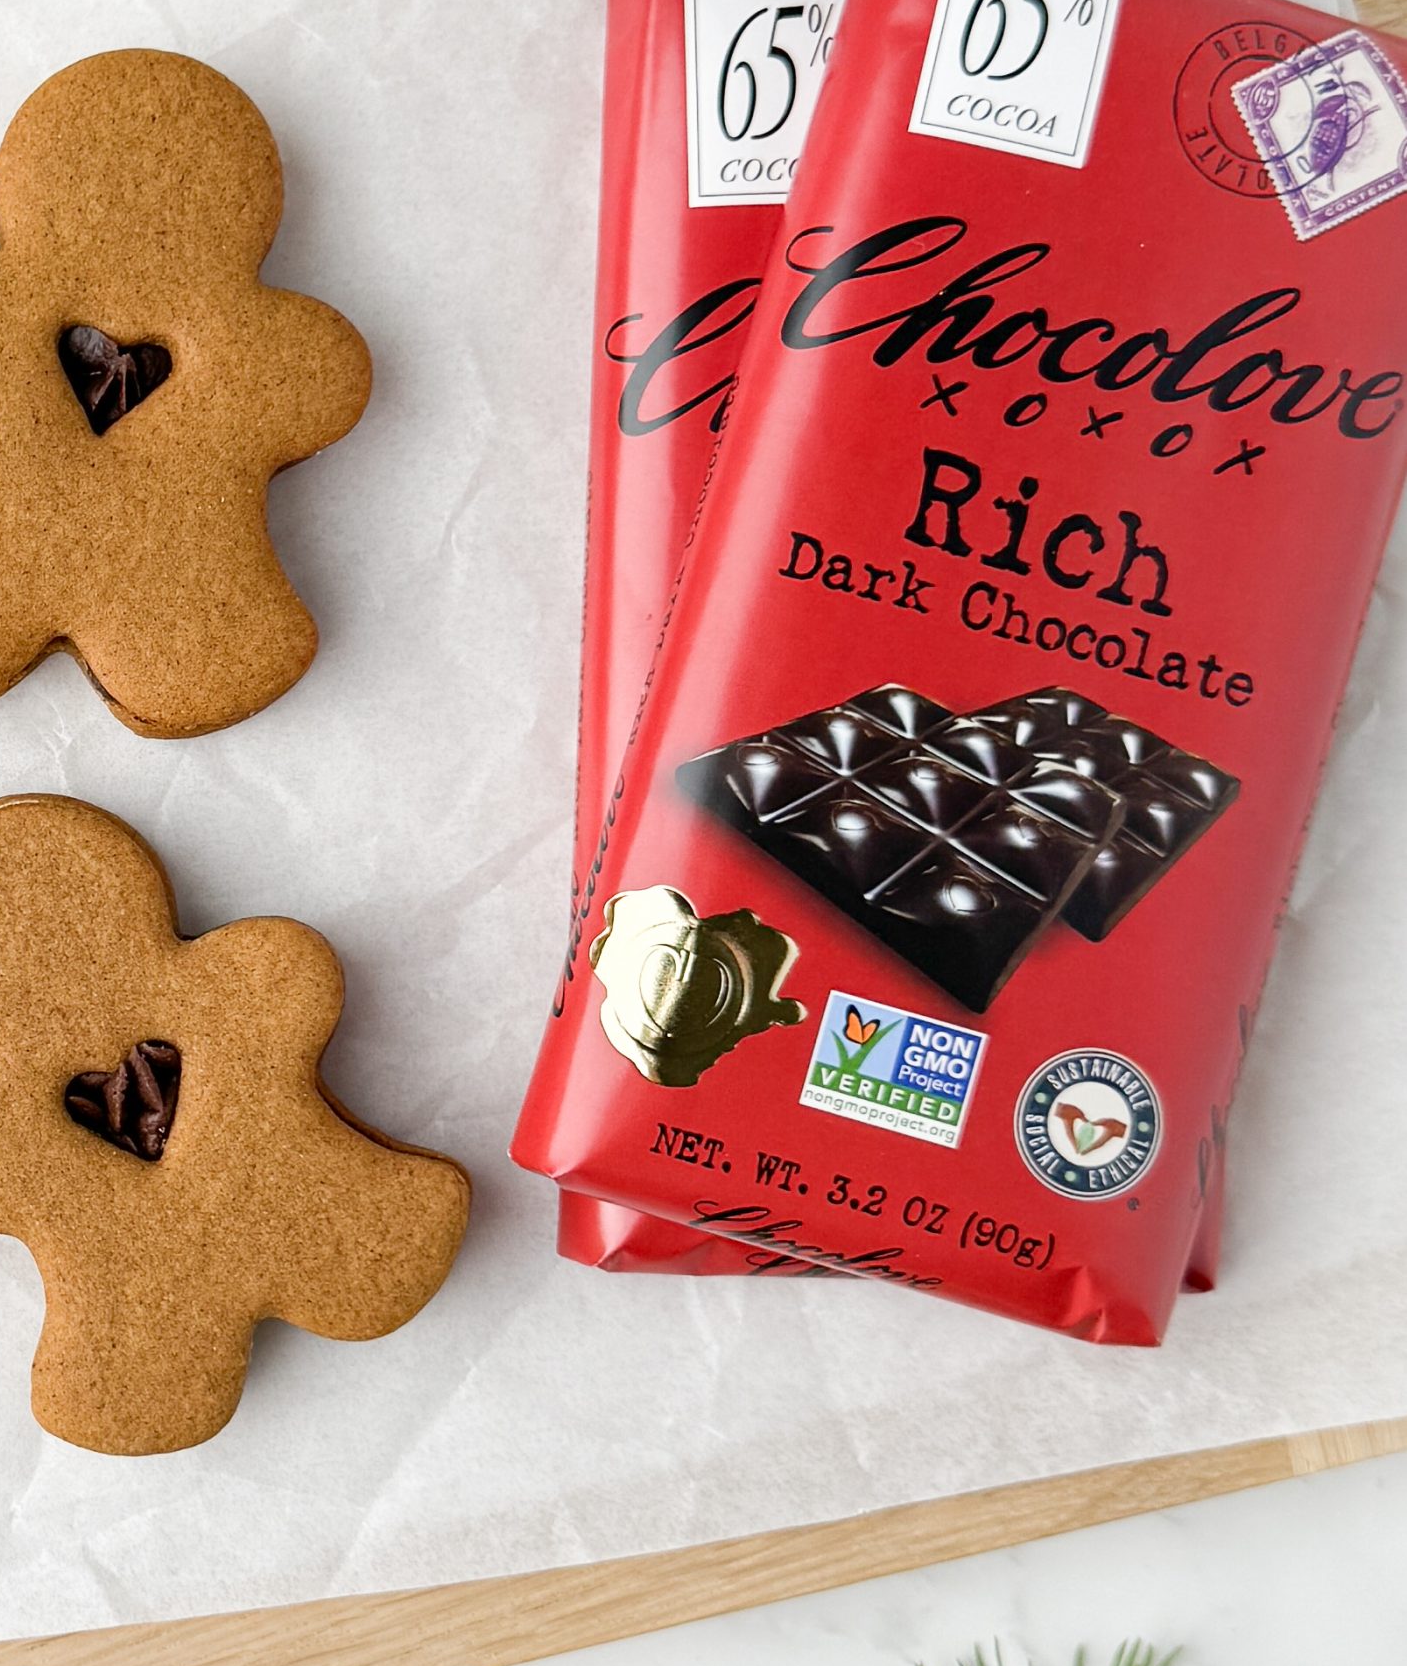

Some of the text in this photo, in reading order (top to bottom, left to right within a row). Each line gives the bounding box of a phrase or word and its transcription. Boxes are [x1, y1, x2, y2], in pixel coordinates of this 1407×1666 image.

[1369, 51, 1407, 105] DAR
[946, 94, 1059, 138] COCOA
[720, 158, 800, 183] COC
[1324, 178, 1398, 217] CONTENT
[780, 215, 1404, 439] Chocolove
[904, 446, 1173, 617] Rich
[779, 531, 1254, 706] Dark Chocolate
[903, 1045, 968, 1079] GMO
[909, 1024, 974, 1059] NON
[820, 1067, 957, 1121] VERIFIED
[897, 1064, 963, 1097] Project
[1046, 1058, 1152, 1111] SUSTAINABLE
[804, 1088, 956, 1144] nongmoproject.org
[1025, 1114, 1061, 1175] SOCIAL
[1089, 1138, 1150, 1189] ETHICAL
[650, 1123, 1056, 1271] NET. WT. 3.2 OZ (90g)
